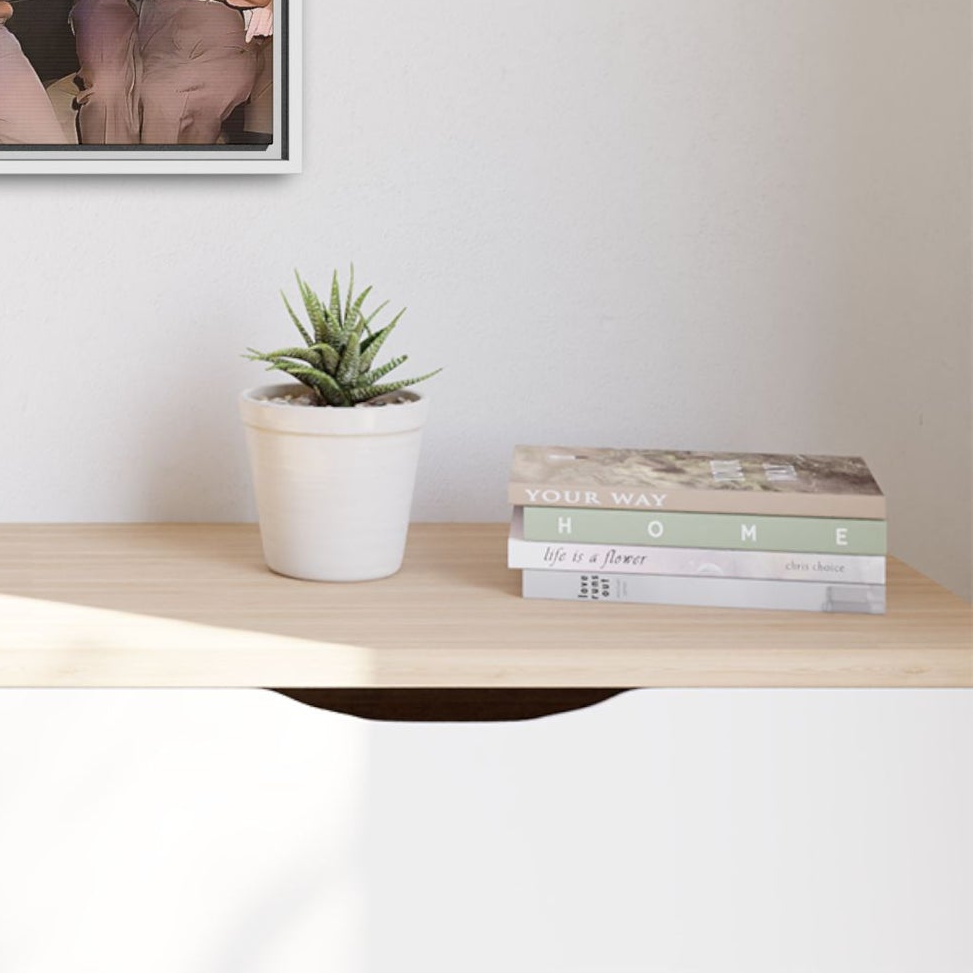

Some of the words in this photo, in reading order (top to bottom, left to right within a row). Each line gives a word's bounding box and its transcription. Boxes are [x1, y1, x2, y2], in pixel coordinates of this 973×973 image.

[525, 489, 600, 505] YOUR
[610, 492, 667, 507] WAY
[543, 546, 567, 567] life
[572, 550, 585, 563] is
[588, 553, 598, 564] a
[600, 548, 648, 569] flower
[785, 559, 810, 572] chris
[812, 560, 846, 573] choice
[578, 575, 589, 598] love
[591, 575, 599, 600] runs
[601, 578, 610, 597] out
